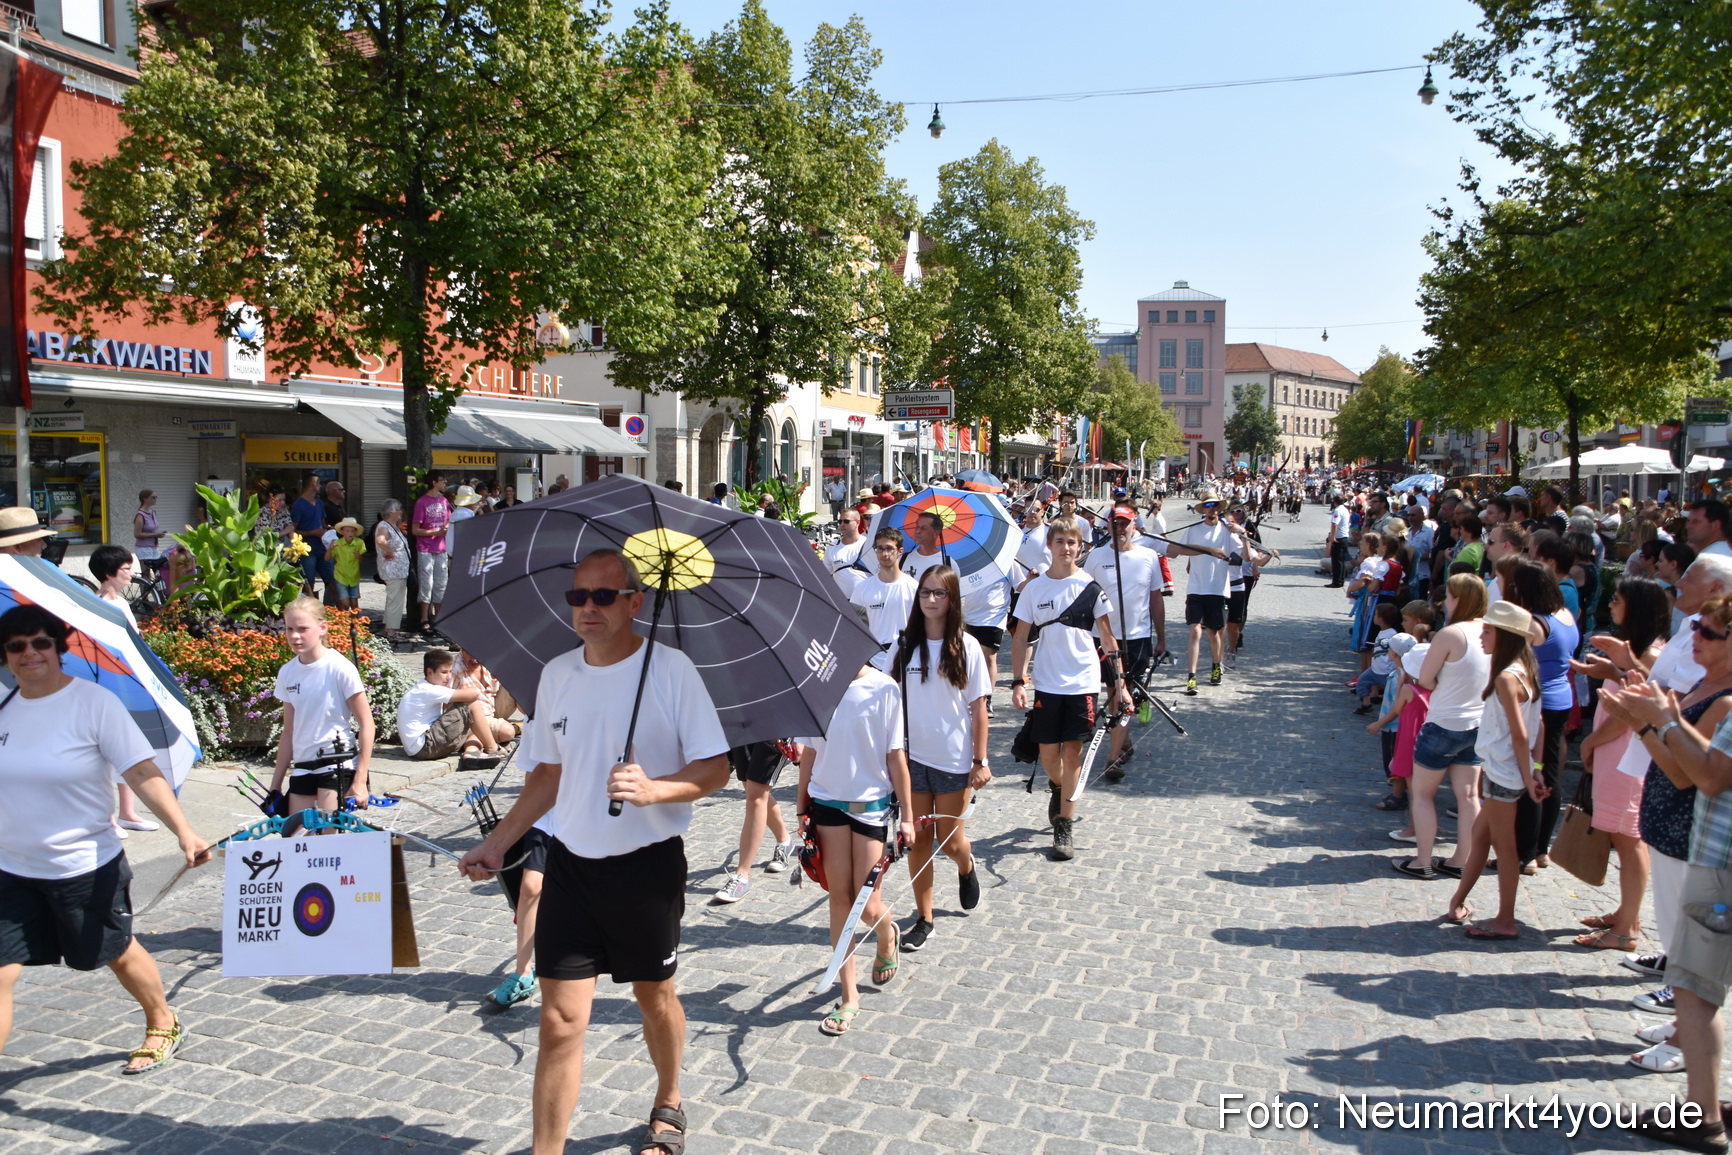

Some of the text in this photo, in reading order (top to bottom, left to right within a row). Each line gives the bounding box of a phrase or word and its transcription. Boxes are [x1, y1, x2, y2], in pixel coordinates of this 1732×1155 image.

[27, 329, 212, 375] ABAKWAREN
[462, 362, 564, 396] SCHLIERF
[895, 394, 940, 403] Parkleitsystem
[911, 407, 941, 416] Rosengasse
[34, 417, 51, 428] NZ
[192, 423, 232, 431] NEUMARKTER
[284, 451, 338, 463] SCHLIERF
[457, 455, 497, 466] SCHLIERF
[295, 843, 308, 853] DA
[340, 875, 355, 885] MA
[240, 882, 283, 895] BOGEN
[239, 895, 282, 906] SCHÜTZEN
[355, 892, 381, 902] GERN
[238, 906, 281, 928] NEU
[238, 929, 280, 943] MARKT
